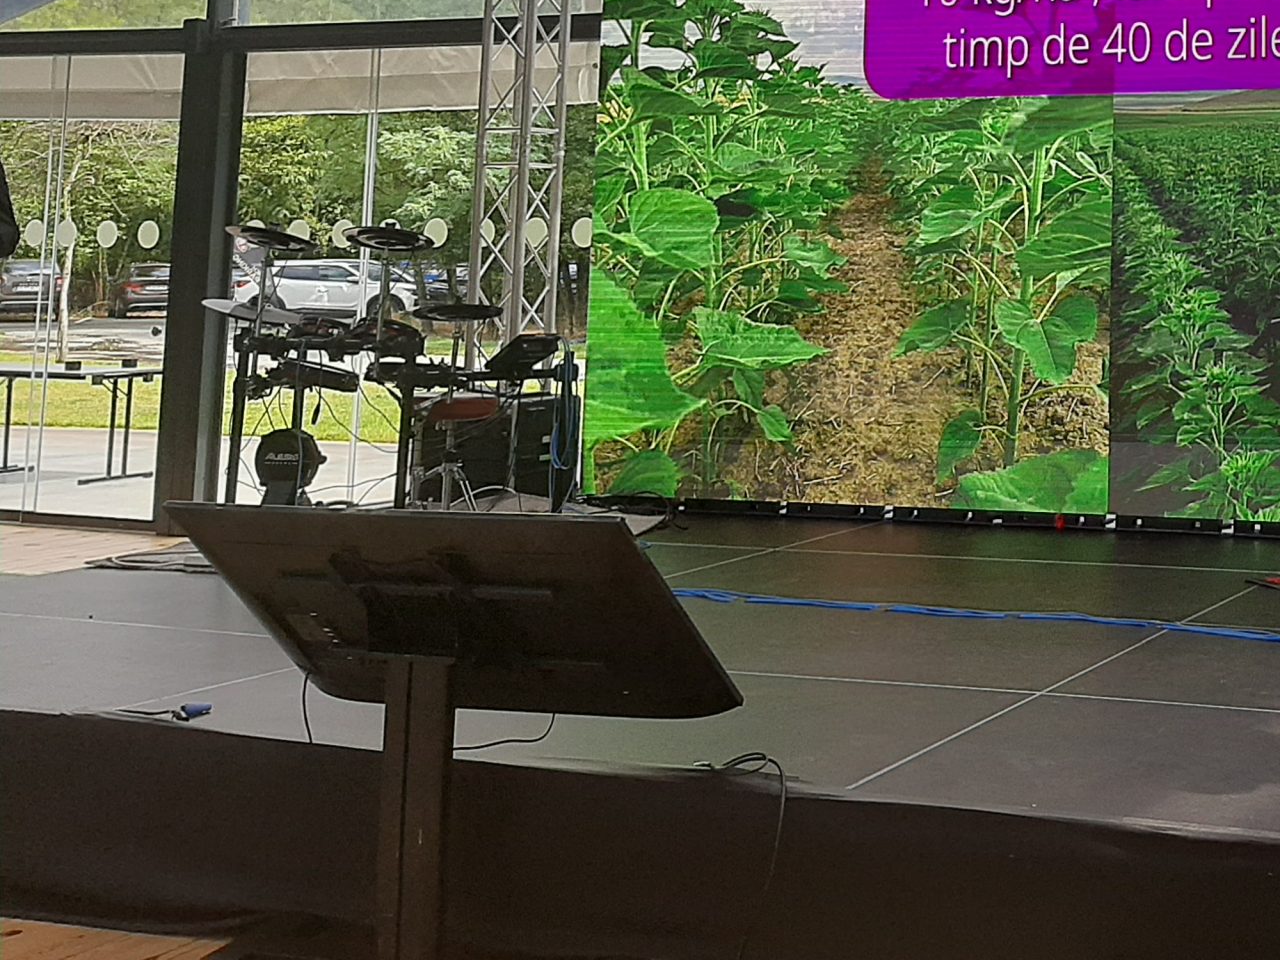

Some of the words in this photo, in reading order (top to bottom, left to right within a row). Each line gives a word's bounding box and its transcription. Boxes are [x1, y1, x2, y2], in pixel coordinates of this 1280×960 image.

[943, 28, 1029, 78] timp
[1043, 21, 1089, 65] de
[1102, 21, 1151, 63] 40
[1165, 18, 1213, 60] de
